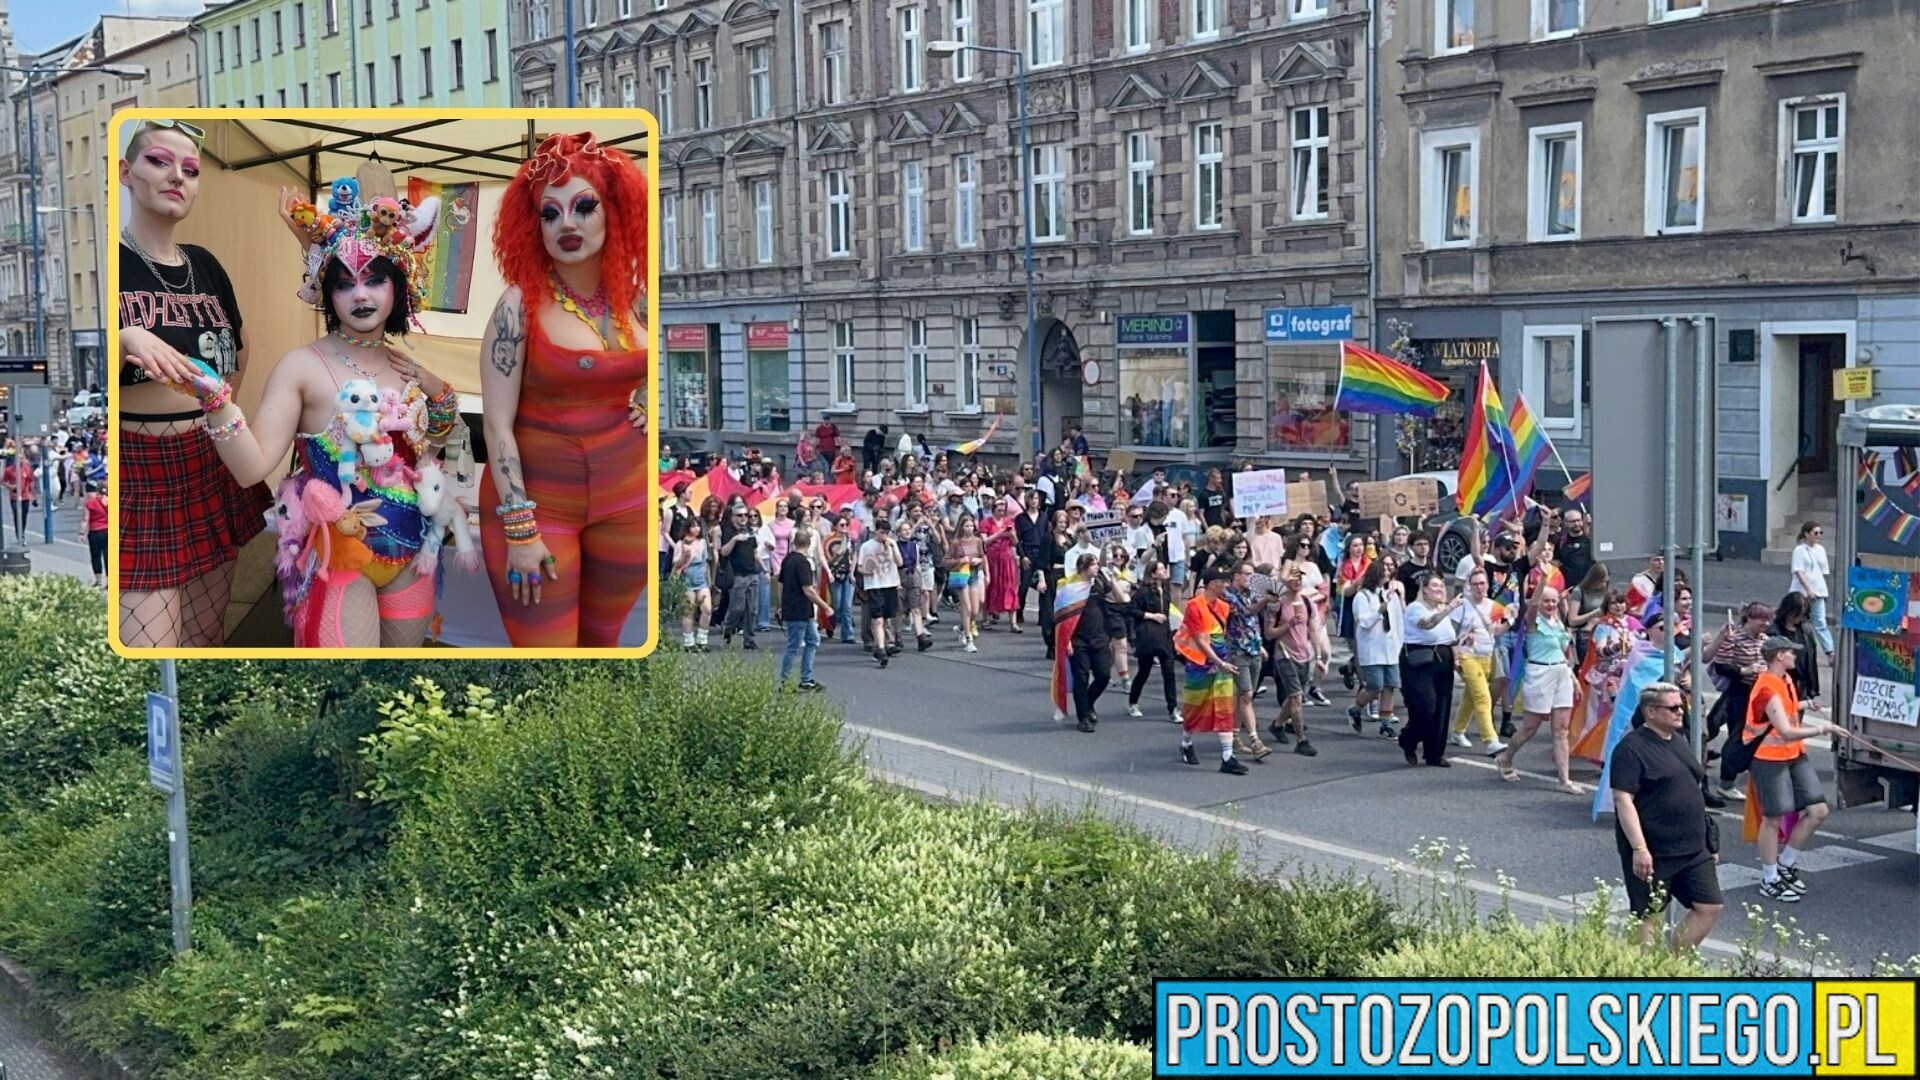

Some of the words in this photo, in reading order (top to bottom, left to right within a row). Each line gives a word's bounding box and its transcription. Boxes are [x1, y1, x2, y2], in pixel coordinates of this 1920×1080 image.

[1121, 317, 1174, 333] MERINO
[1290, 314, 1352, 336] fotograf
[1432, 341, 1500, 358] WIATORIA
[152, 704, 167, 762] P
